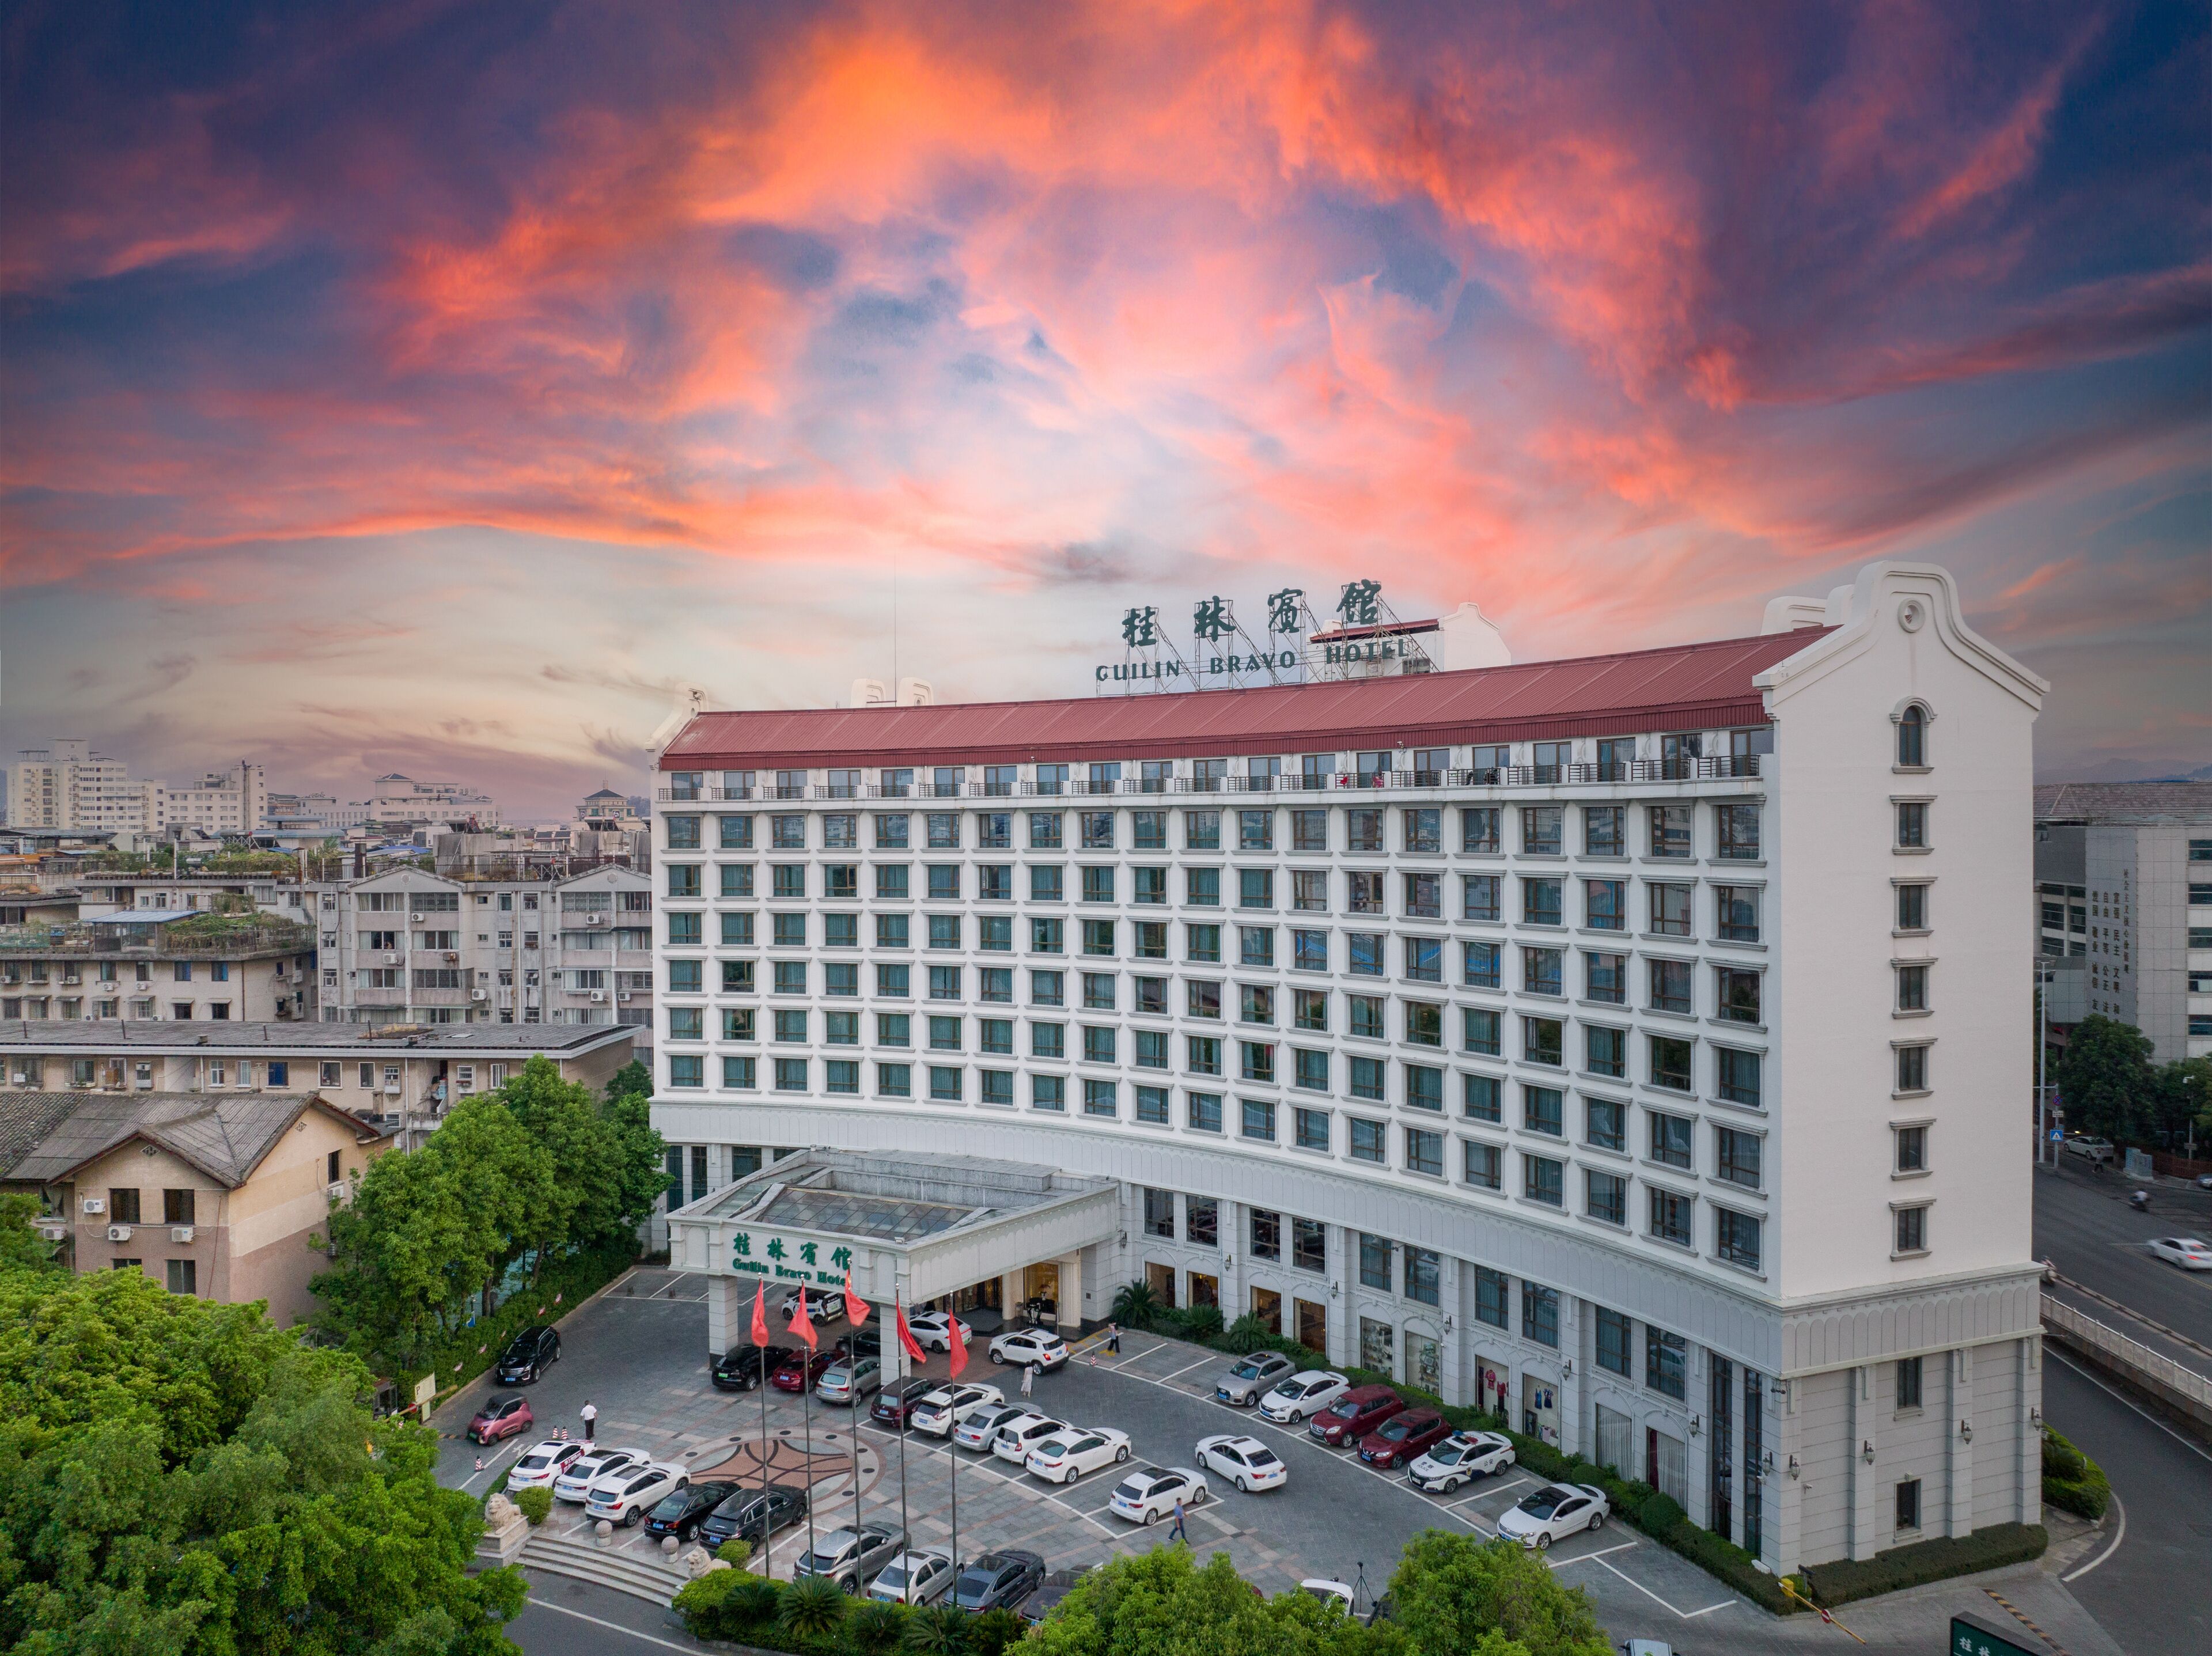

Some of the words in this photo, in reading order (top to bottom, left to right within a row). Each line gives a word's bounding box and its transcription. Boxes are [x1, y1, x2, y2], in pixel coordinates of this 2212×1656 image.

[1096, 660, 1180, 681] GUILIN
[1210, 651, 1296, 674] BRAVO
[1326, 639, 1408, 664] HOTEL
[733, 1257, 769, 1274] Guilin
[775, 1264, 812, 1280] Bravo
[817, 1271, 846, 1286] Hote
